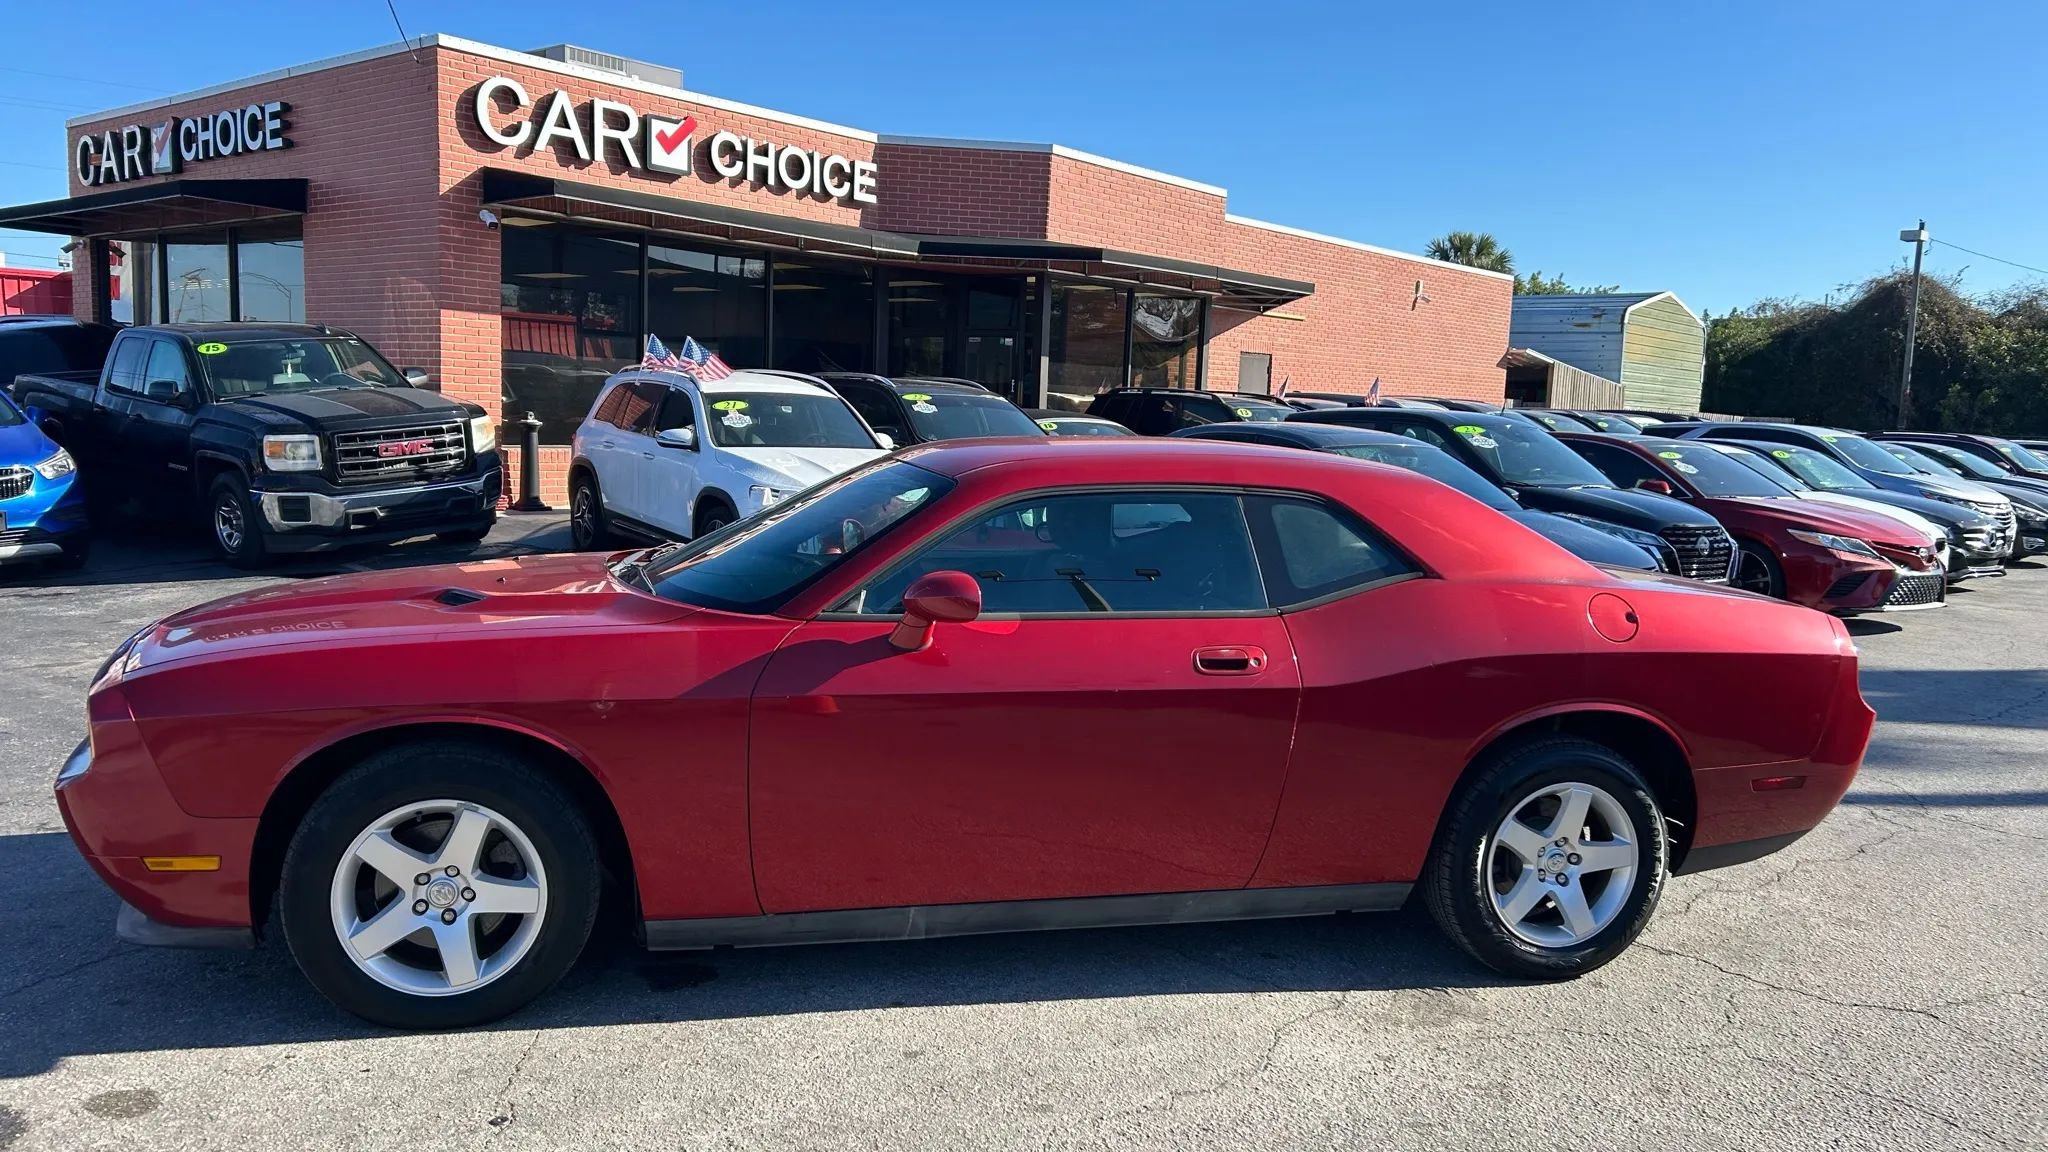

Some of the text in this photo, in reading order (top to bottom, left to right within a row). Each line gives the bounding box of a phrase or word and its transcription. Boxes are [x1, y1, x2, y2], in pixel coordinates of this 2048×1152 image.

[76, 102, 284, 187] CAR CHOICE
[474, 75, 877, 204] CAR CHOICE
[204, 344, 220, 352] 15
[378, 439, 434, 458] GMC
